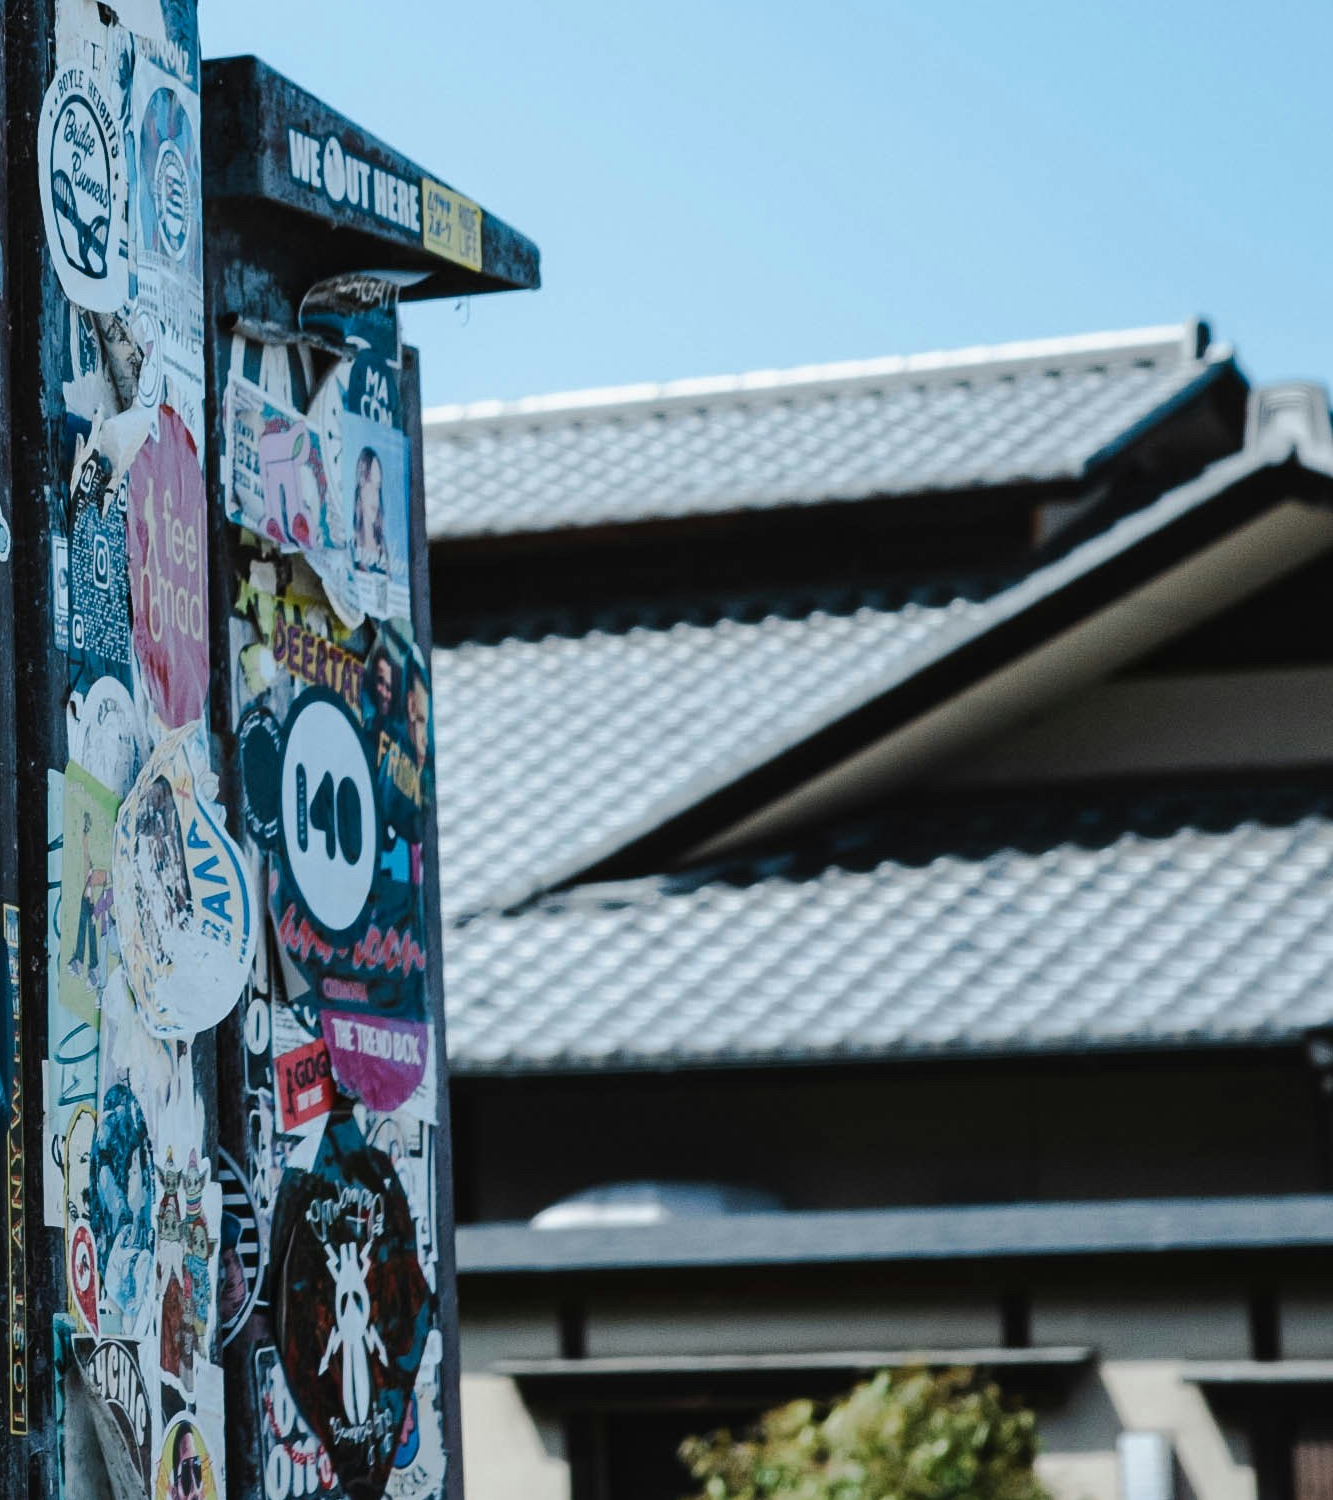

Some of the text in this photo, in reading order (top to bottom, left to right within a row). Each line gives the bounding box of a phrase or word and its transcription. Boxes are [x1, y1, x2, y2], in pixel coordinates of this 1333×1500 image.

[58, 69, 84, 95] BOYLE
[65, 108, 95, 157] Bridge
[71, 152, 109, 209] Runners
[288, 128, 322, 188] WE
[374, 168, 421, 233] HERE
[332, 1017, 422, 1065] THE TREND BOX
